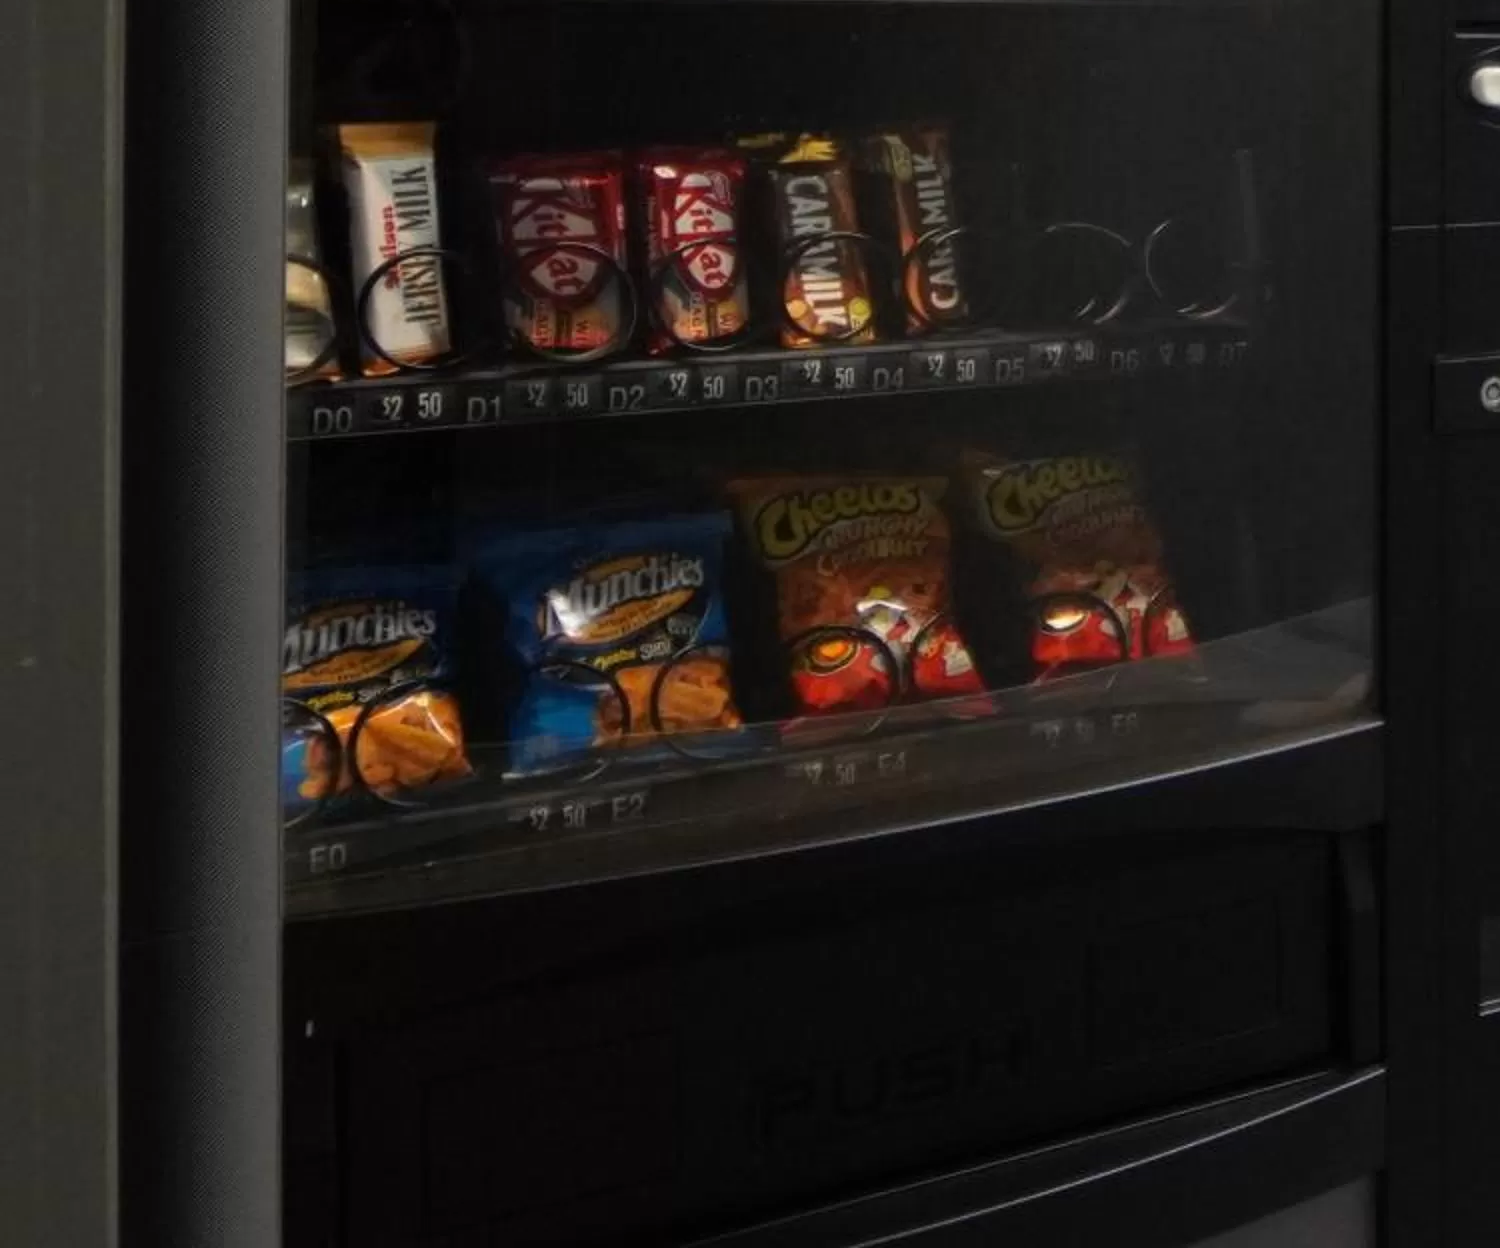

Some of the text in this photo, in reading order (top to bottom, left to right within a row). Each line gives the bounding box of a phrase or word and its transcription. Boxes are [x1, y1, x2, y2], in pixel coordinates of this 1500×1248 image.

[391, 165, 432, 231] MILK
[311, 406, 354, 435] D0
[467, 396, 500, 423] D1
[609, 386, 646, 411] D2
[745, 376, 779, 401] D3
[873, 366, 905, 391] D4
[995, 357, 1025, 384] D5
[755, 482, 921, 560] Cheetos
[542, 551, 705, 641] Munchies
[611, 794, 646, 822] E2
[309, 844, 347, 874] E0
